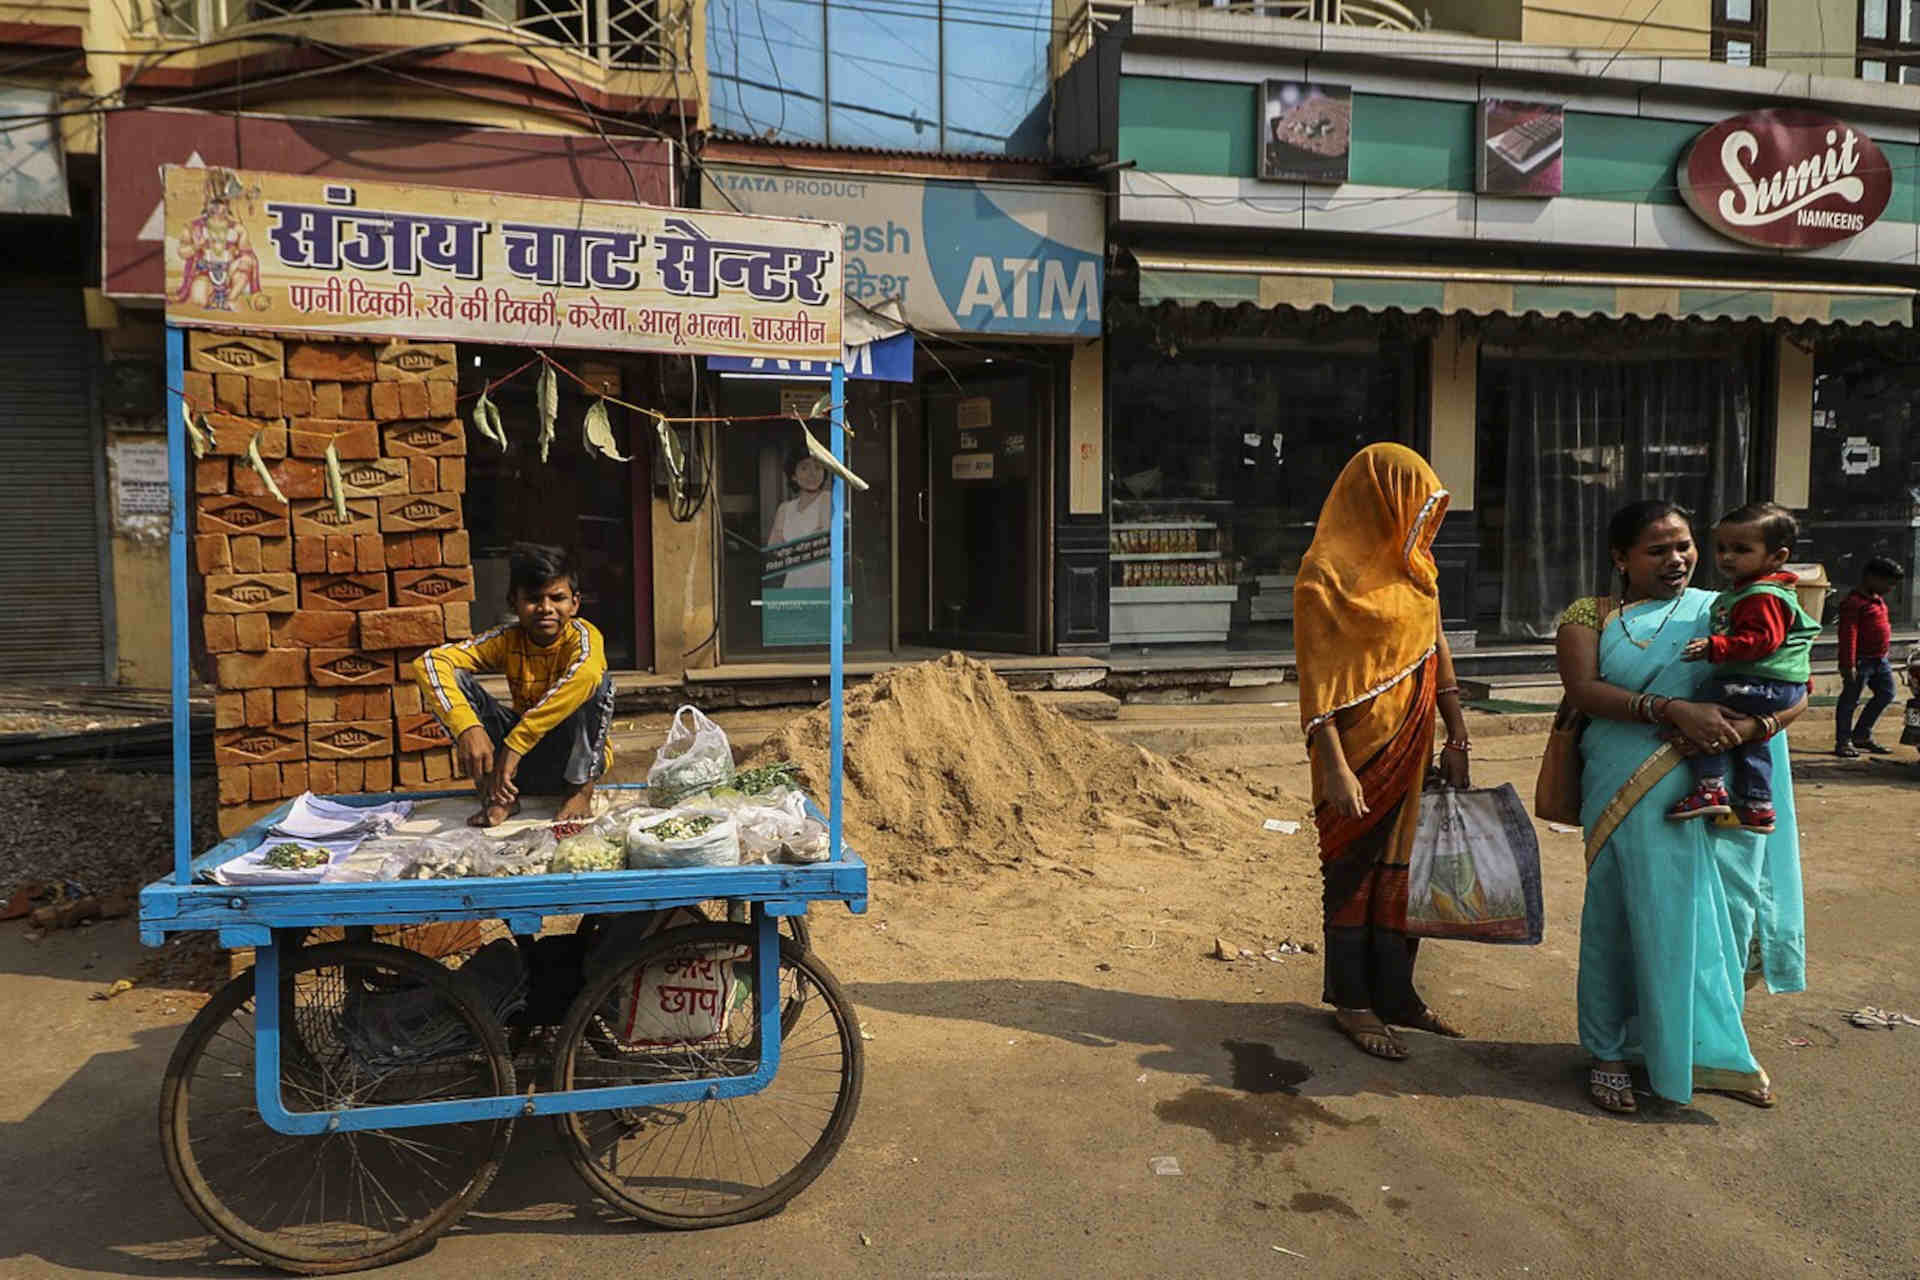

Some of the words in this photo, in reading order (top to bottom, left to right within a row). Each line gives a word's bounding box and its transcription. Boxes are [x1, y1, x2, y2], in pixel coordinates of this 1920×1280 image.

[727, 175, 778, 193] TATA
[784, 179, 868, 199] PRODUCT
[1718, 128, 1864, 226] Sumit
[266, 183, 491, 280] संजय
[502, 222, 645, 291] चाट
[654, 217, 833, 306] सेन्टर
[845, 220, 911, 254] ash
[1797, 208, 1864, 232] NAMKEENS
[290, 276, 341, 312] पानी
[427, 285, 453, 319] रवे
[460, 287, 489, 322] की
[568, 296, 633, 333] करेला,
[639, 308, 686, 345] आलू
[752, 310, 826, 344] चाउमीन
[956, 255, 1101, 321] ATM
[658, 985, 718, 1017] छाप
